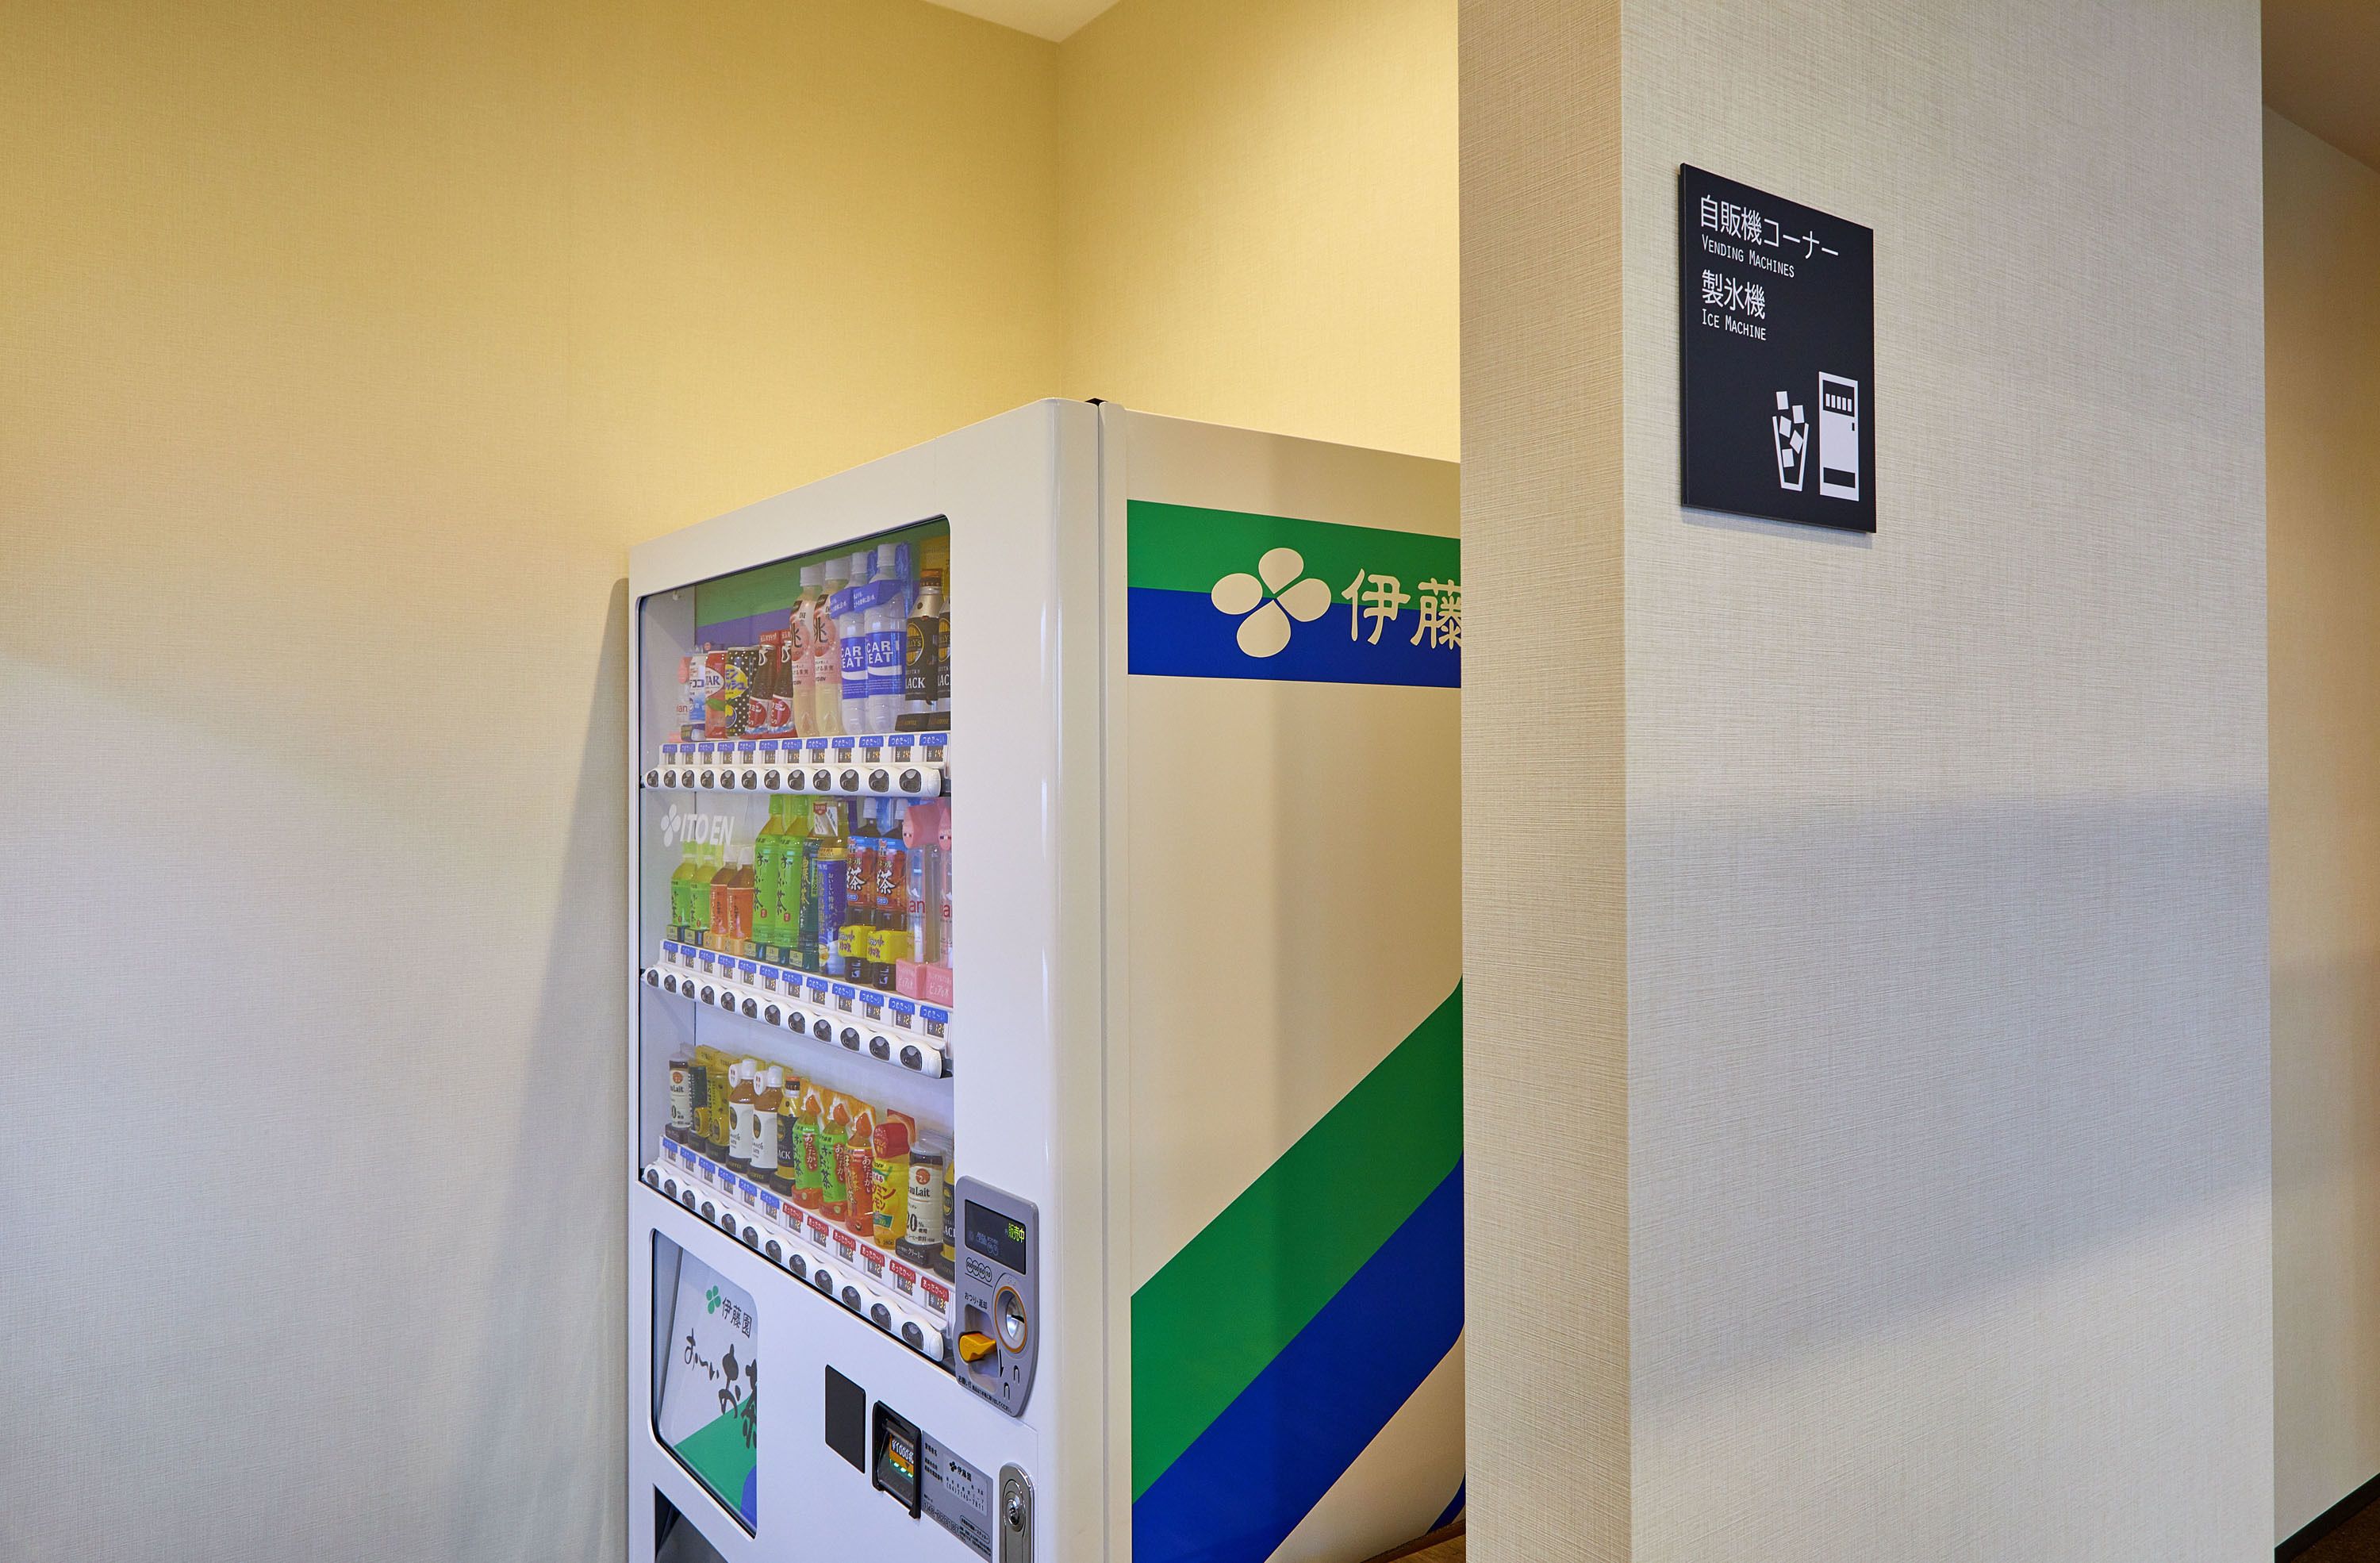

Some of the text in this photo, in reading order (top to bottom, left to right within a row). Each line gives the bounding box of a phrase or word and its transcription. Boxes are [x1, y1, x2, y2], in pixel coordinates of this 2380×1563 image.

[1700, 194, 1839, 259] 自販機コーナー
[1702, 234, 1795, 278] VENDING MACHINES
[1702, 269, 1766, 319] 製氷機
[1702, 309, 1767, 341] ICE MACHINE
[680, 813, 735, 846] ITO EN
[1008, 1223, 1025, 1243] 販売中
[722, 1296, 753, 1338] 伊藤園
